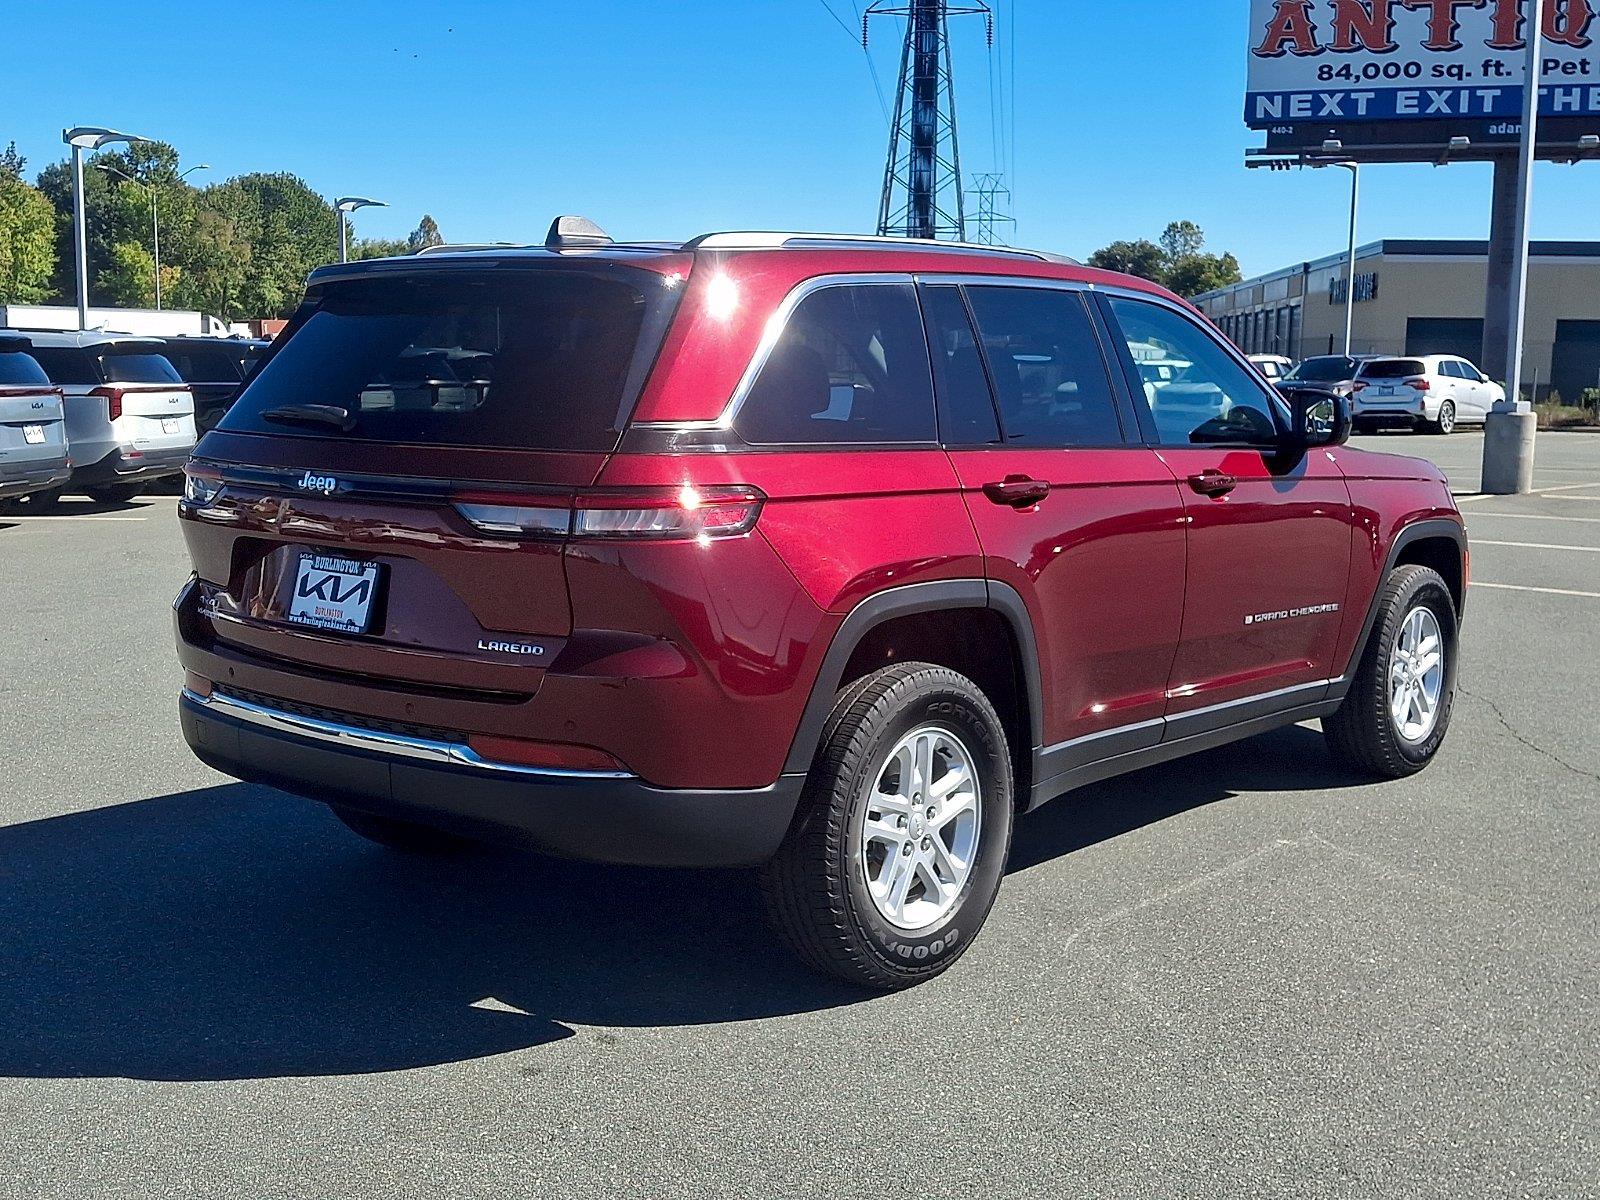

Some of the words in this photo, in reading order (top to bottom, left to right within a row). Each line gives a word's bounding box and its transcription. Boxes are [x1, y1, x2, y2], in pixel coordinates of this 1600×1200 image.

[1317, 61, 1422, 83] 84,000
[1431, 63, 1472, 81] sq.
[1481, 59, 1512, 77] ft.
[1542, 58, 1591, 76] Pet
[1256, 92, 1376, 118] NEXT
[1396, 89, 1502, 114] EXIT
[297, 470, 336, 496] Jeep
[314, 556, 361, 574] BURLINGTON
[298, 571, 370, 606] KIA
[1254, 610, 1288, 622] GRAND
[1289, 603, 1340, 617] CHEROKEE
[477, 639, 545, 656] LAREDO
